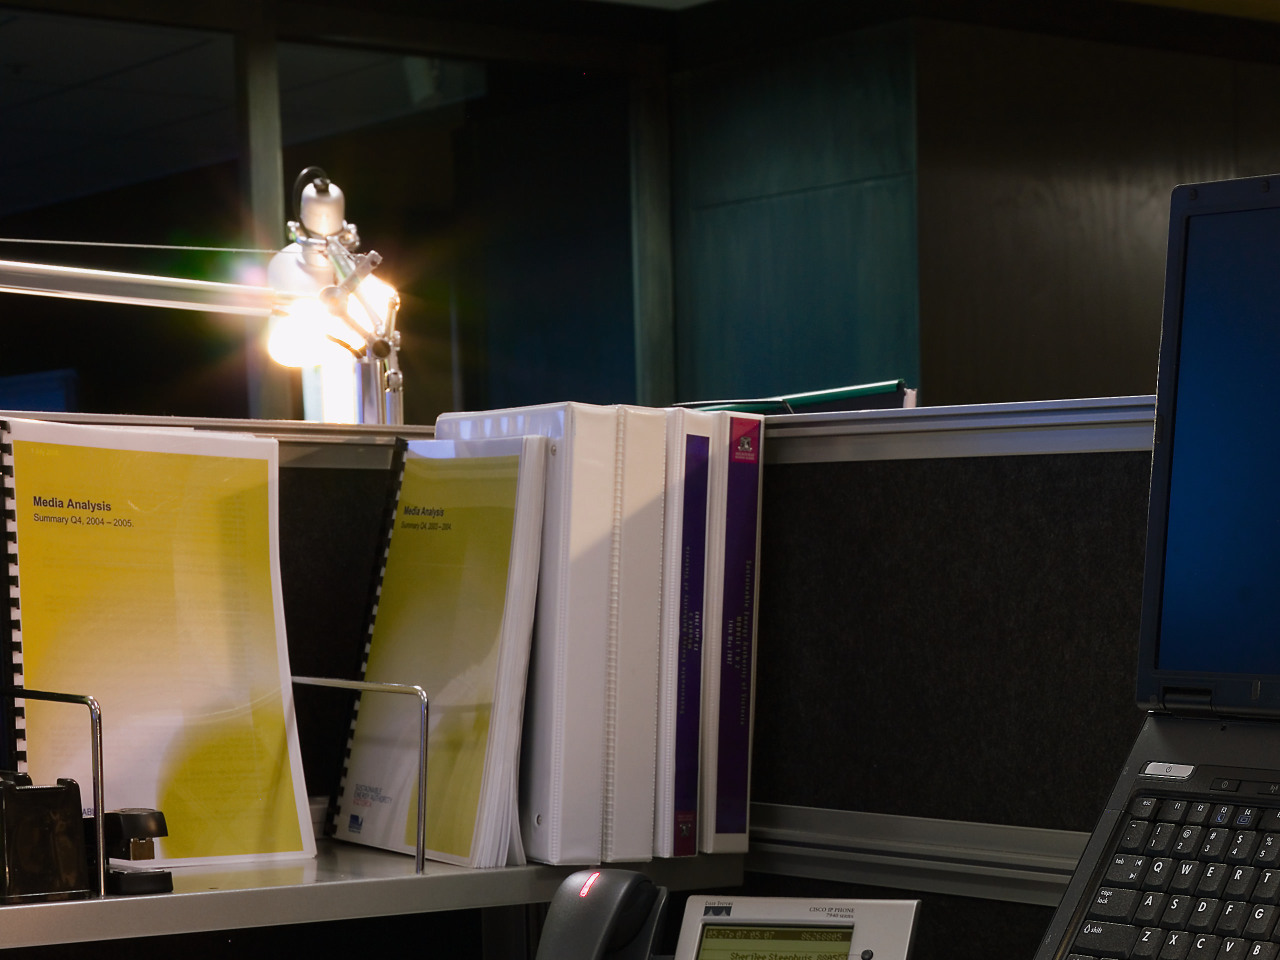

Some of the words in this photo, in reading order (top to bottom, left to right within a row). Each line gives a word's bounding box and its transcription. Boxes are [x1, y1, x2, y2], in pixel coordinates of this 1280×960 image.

[33, 496, 64, 508] Media
[67, 498, 111, 513] Analysis
[404, 506, 420, 516] Media
[420, 506, 444, 519] Analysis
[33, 513, 69, 525] Summary
[86, 517, 105, 526] 2004
[1154, 862, 1162, 873] Q
[1182, 864, 1192, 875] W
[1207, 866, 1214, 876] E
[1234, 870, 1242, 880] R
[1264, 872, 1272, 882] T
[1144, 896, 1153, 906] A
[1170, 899, 1178, 909] S
[1198, 902, 1206, 912] D
[1226, 904, 1234, 914] F
[1254, 908, 1264, 919] G
[1142, 931, 1152, 942] Z
[1168, 934, 1178, 945] X
[1196, 938, 1206, 948] C
[1226, 942, 1234, 952] V
[1252, 944, 1261, 955] B
